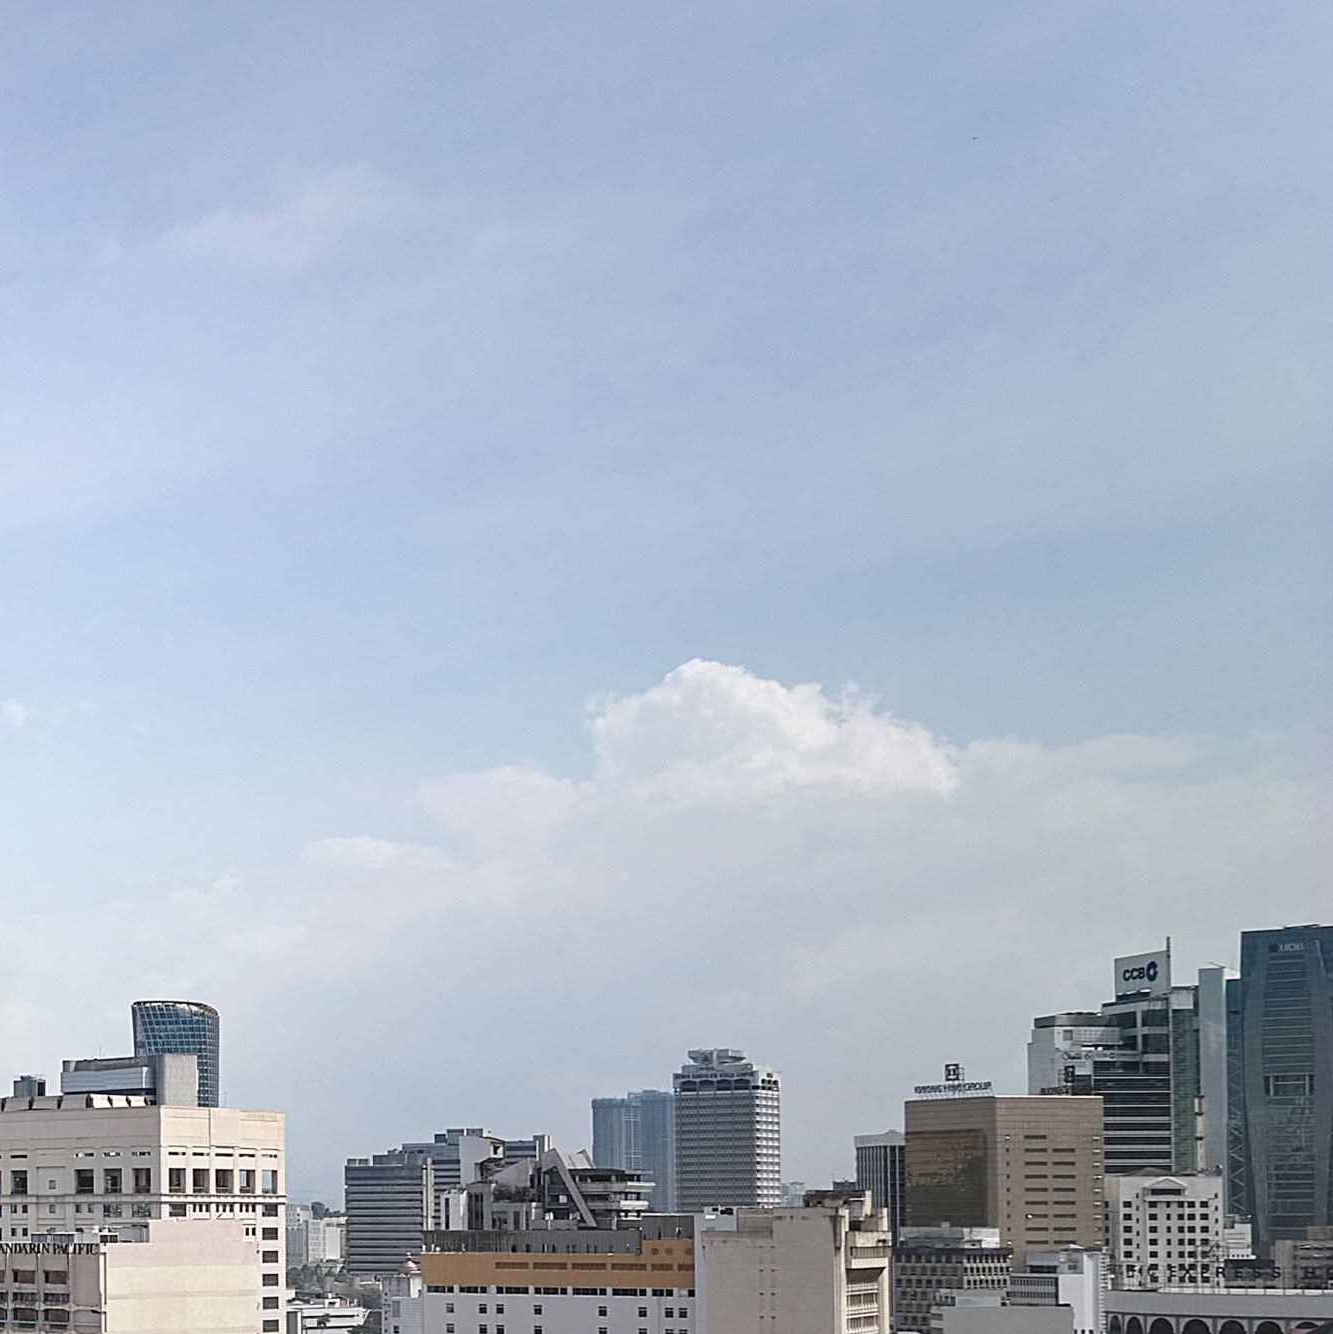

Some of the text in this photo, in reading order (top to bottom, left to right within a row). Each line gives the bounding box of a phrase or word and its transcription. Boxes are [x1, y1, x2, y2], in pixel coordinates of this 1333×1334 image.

[1123, 967, 1145, 982] CCB
[53, 1242, 99, 1256] PACIFIC
[1170, 1265, 1282, 1279] EXPRESS
